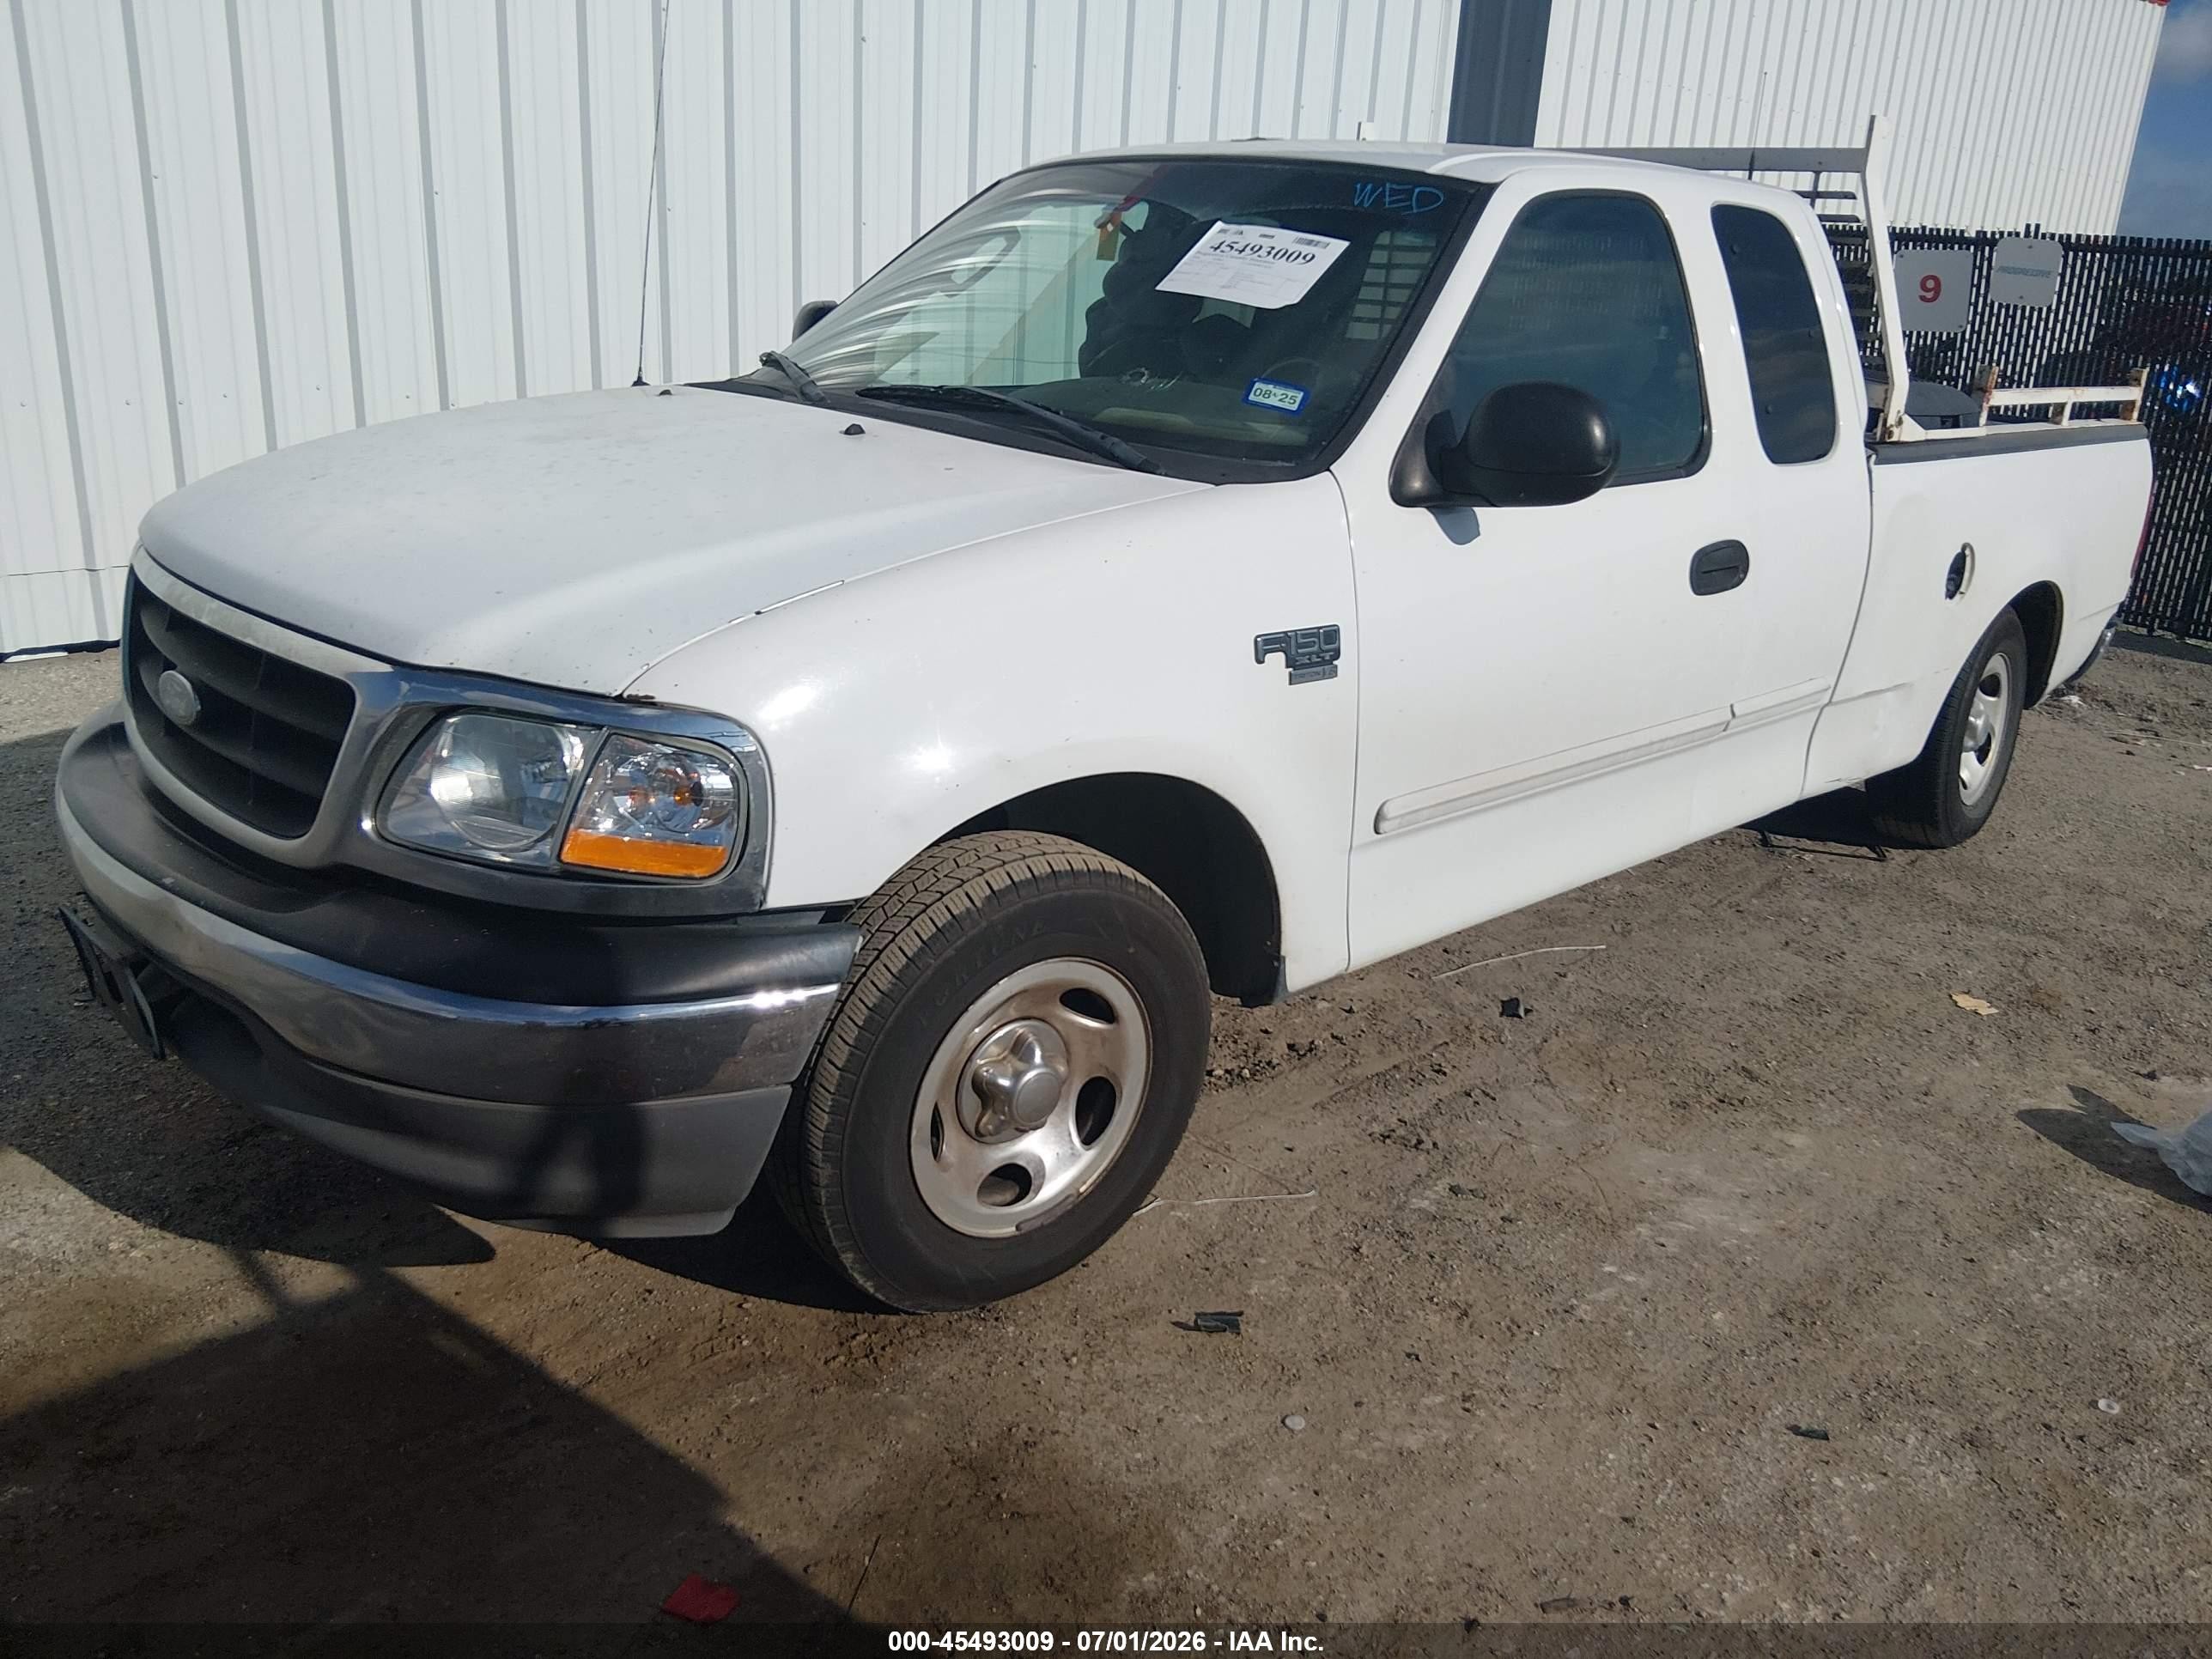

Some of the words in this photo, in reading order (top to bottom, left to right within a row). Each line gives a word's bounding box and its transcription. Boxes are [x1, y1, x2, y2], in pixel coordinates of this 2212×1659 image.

[1354, 182, 1443, 215] WED
[1209, 240, 1316, 265] 45493009
[1919, 275, 1941, 302] 9
